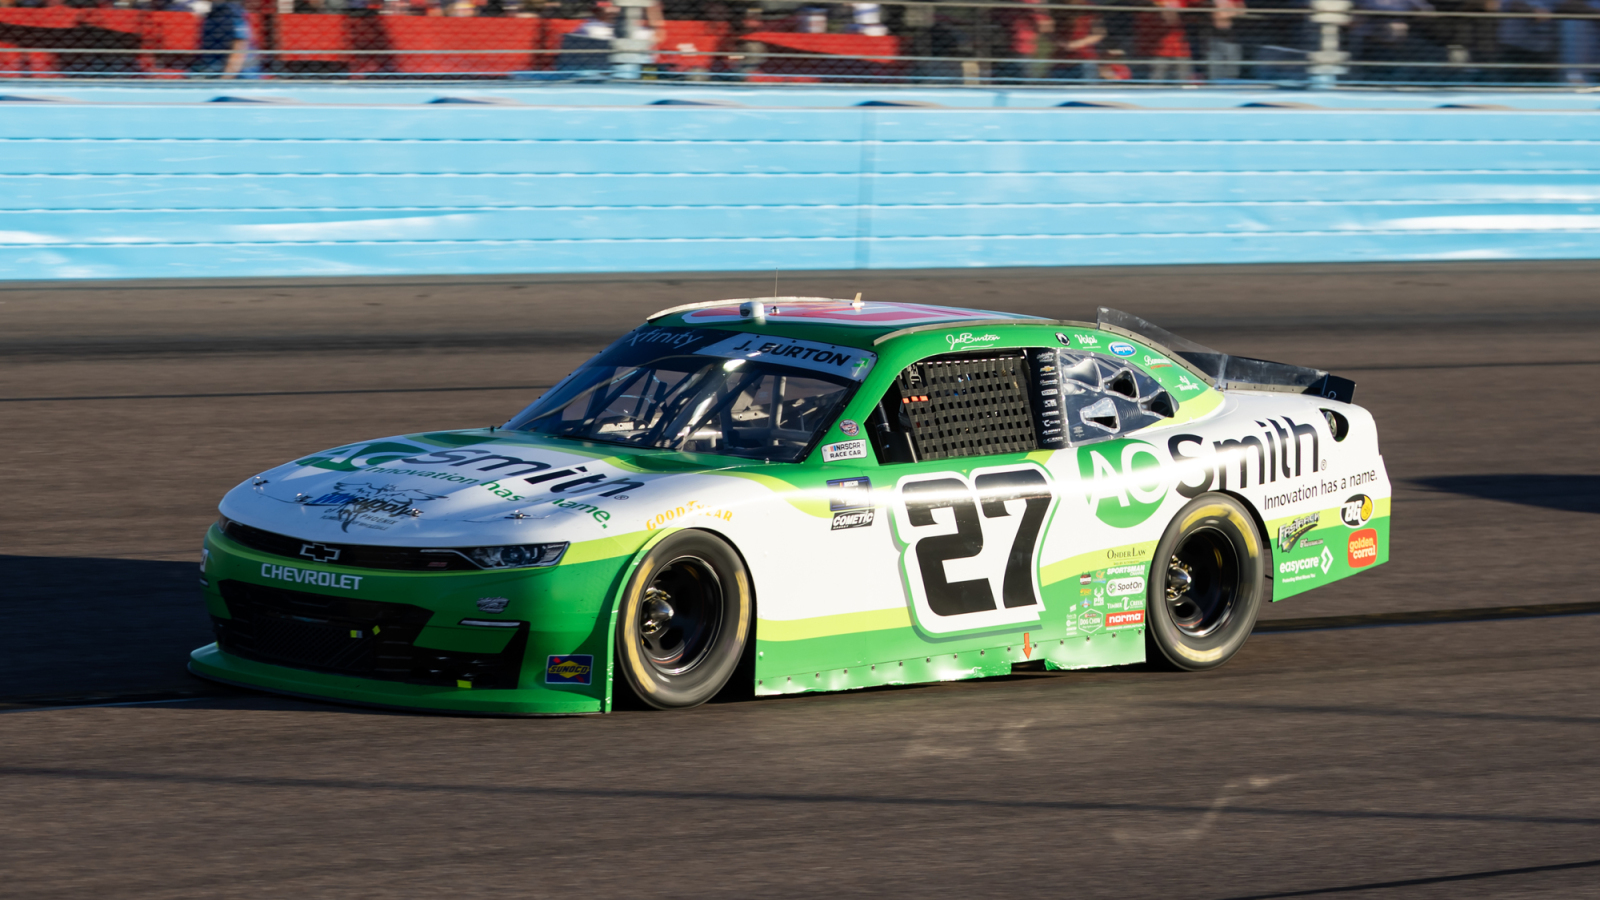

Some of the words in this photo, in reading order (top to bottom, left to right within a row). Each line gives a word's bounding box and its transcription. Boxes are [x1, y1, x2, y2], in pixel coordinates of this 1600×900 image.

[626, 328, 704, 349] xfinity
[733, 338, 748, 351] J.
[759, 341, 852, 367] BURTON
[830, 451, 847, 459] RACE
[836, 442, 861, 451] NASCAR
[480, 479, 525, 502] has
[1264, 484, 1318, 510] Innovation
[1320, 481, 1338, 495] has
[1340, 479, 1347, 490] a
[1349, 469, 1378, 487] name.
[832, 509, 874, 527] COMETIC
[1343, 500, 1363, 523] BG
[902, 468, 1052, 617] 27
[1349, 537, 1374, 553] golden
[1353, 545, 1376, 559] corral
[1106, 564, 1146, 575] SPORTSMAN
[1279, 556, 1319, 574] easycare
[261, 563, 363, 590] CHEVROLET
[1117, 581, 1142, 592] SpotOn
[1109, 612, 1142, 624] norma
[550, 665, 589, 675] SUNOCO
